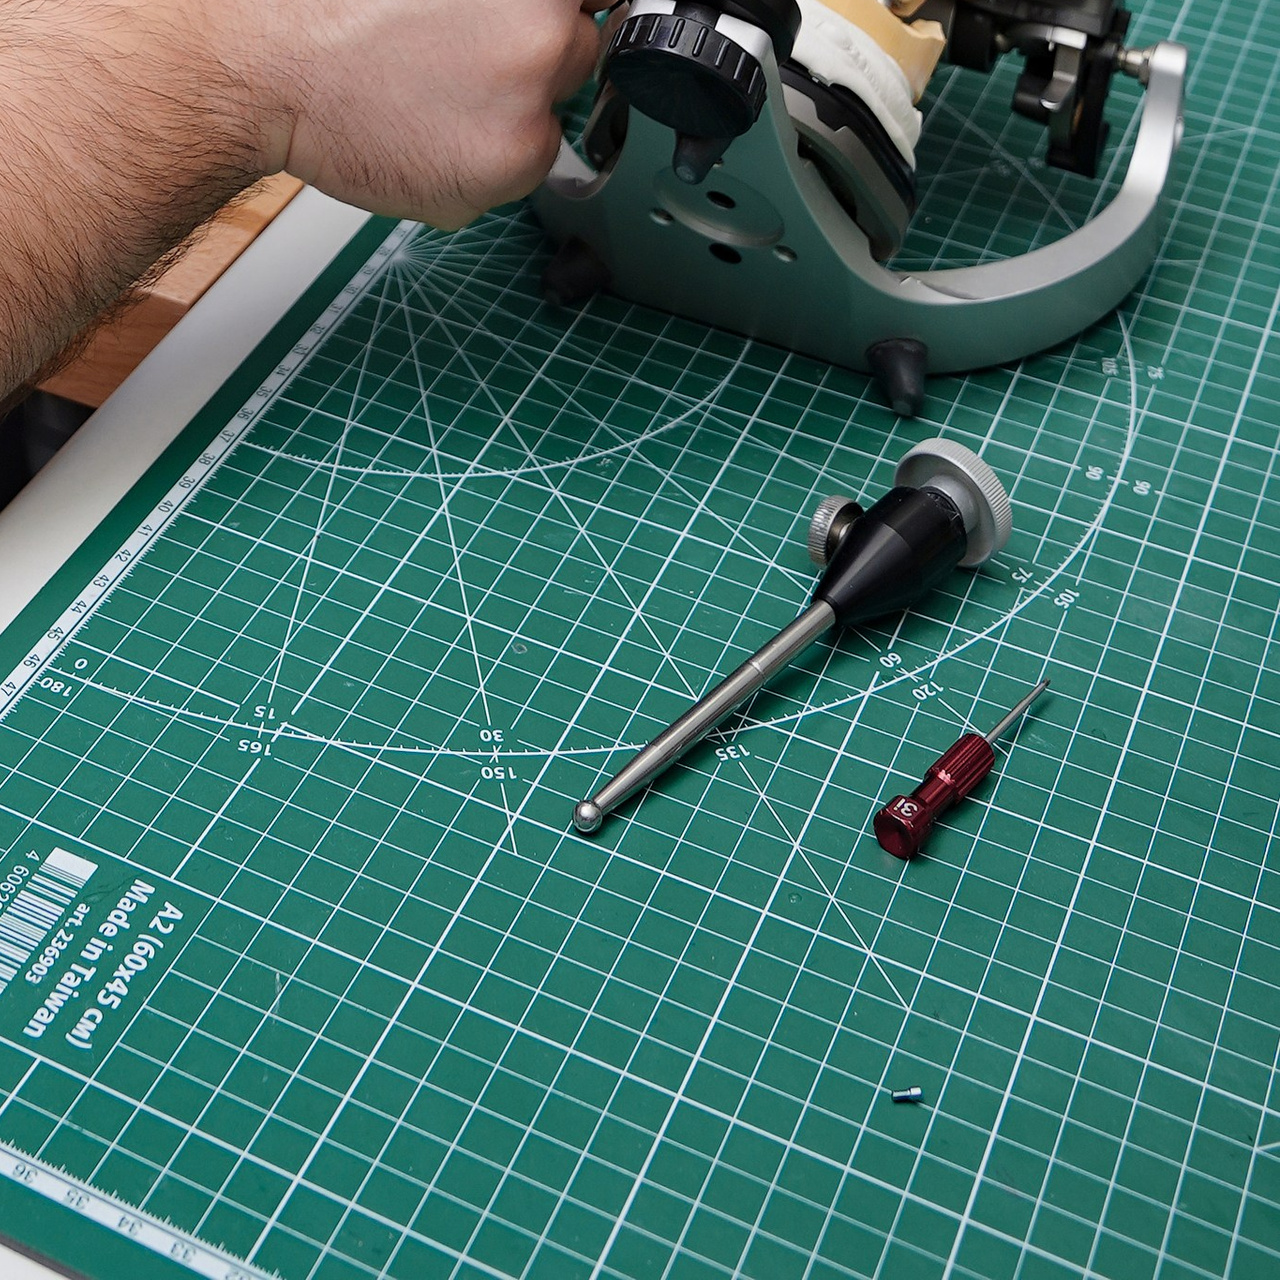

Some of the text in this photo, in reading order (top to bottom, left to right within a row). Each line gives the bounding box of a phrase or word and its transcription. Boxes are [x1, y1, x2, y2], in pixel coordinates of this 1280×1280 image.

[293, 343, 309, 356] 33
[276, 364, 291, 377] 34
[256, 385, 274, 398] 35
[237, 407, 254, 420] 36
[220, 429, 235, 444] 37
[198, 452, 216, 466] 38
[1085, 464, 1104, 482] 90
[178, 475, 196, 489] 39
[1132, 479, 1152, 496] 90
[157, 499, 174, 513] 40
[137, 524, 154, 538] 41
[114, 548, 132, 563] 42
[92, 574, 110, 588] 43
[1011, 566, 1034, 584] 75
[1053, 588, 1080, 609] 105
[70, 600, 88, 615] 44
[47, 626, 65, 641] 45
[23, 653, 41, 669] 46
[74, 658, 88, 670] 0
[879, 652, 902, 668] 60
[0, 681, 17, 697] 47
[40, 676, 74, 698] 180
[912, 681, 944, 701] 120
[253, 705, 276, 720] 15
[479, 729, 504, 742] 30
[237, 739, 272, 756] 165
[715, 743, 751, 761] 135
[480, 766, 517, 779] 150
[25, 849, 41, 862] 4
[148, 901, 184, 935] A2
[24, 902, 91, 985] art. 236903
[22, 878, 156, 1039] Made in Taiwan
[12, 1163, 39, 1184] 36
[63, 1189, 91, 1211] 35
